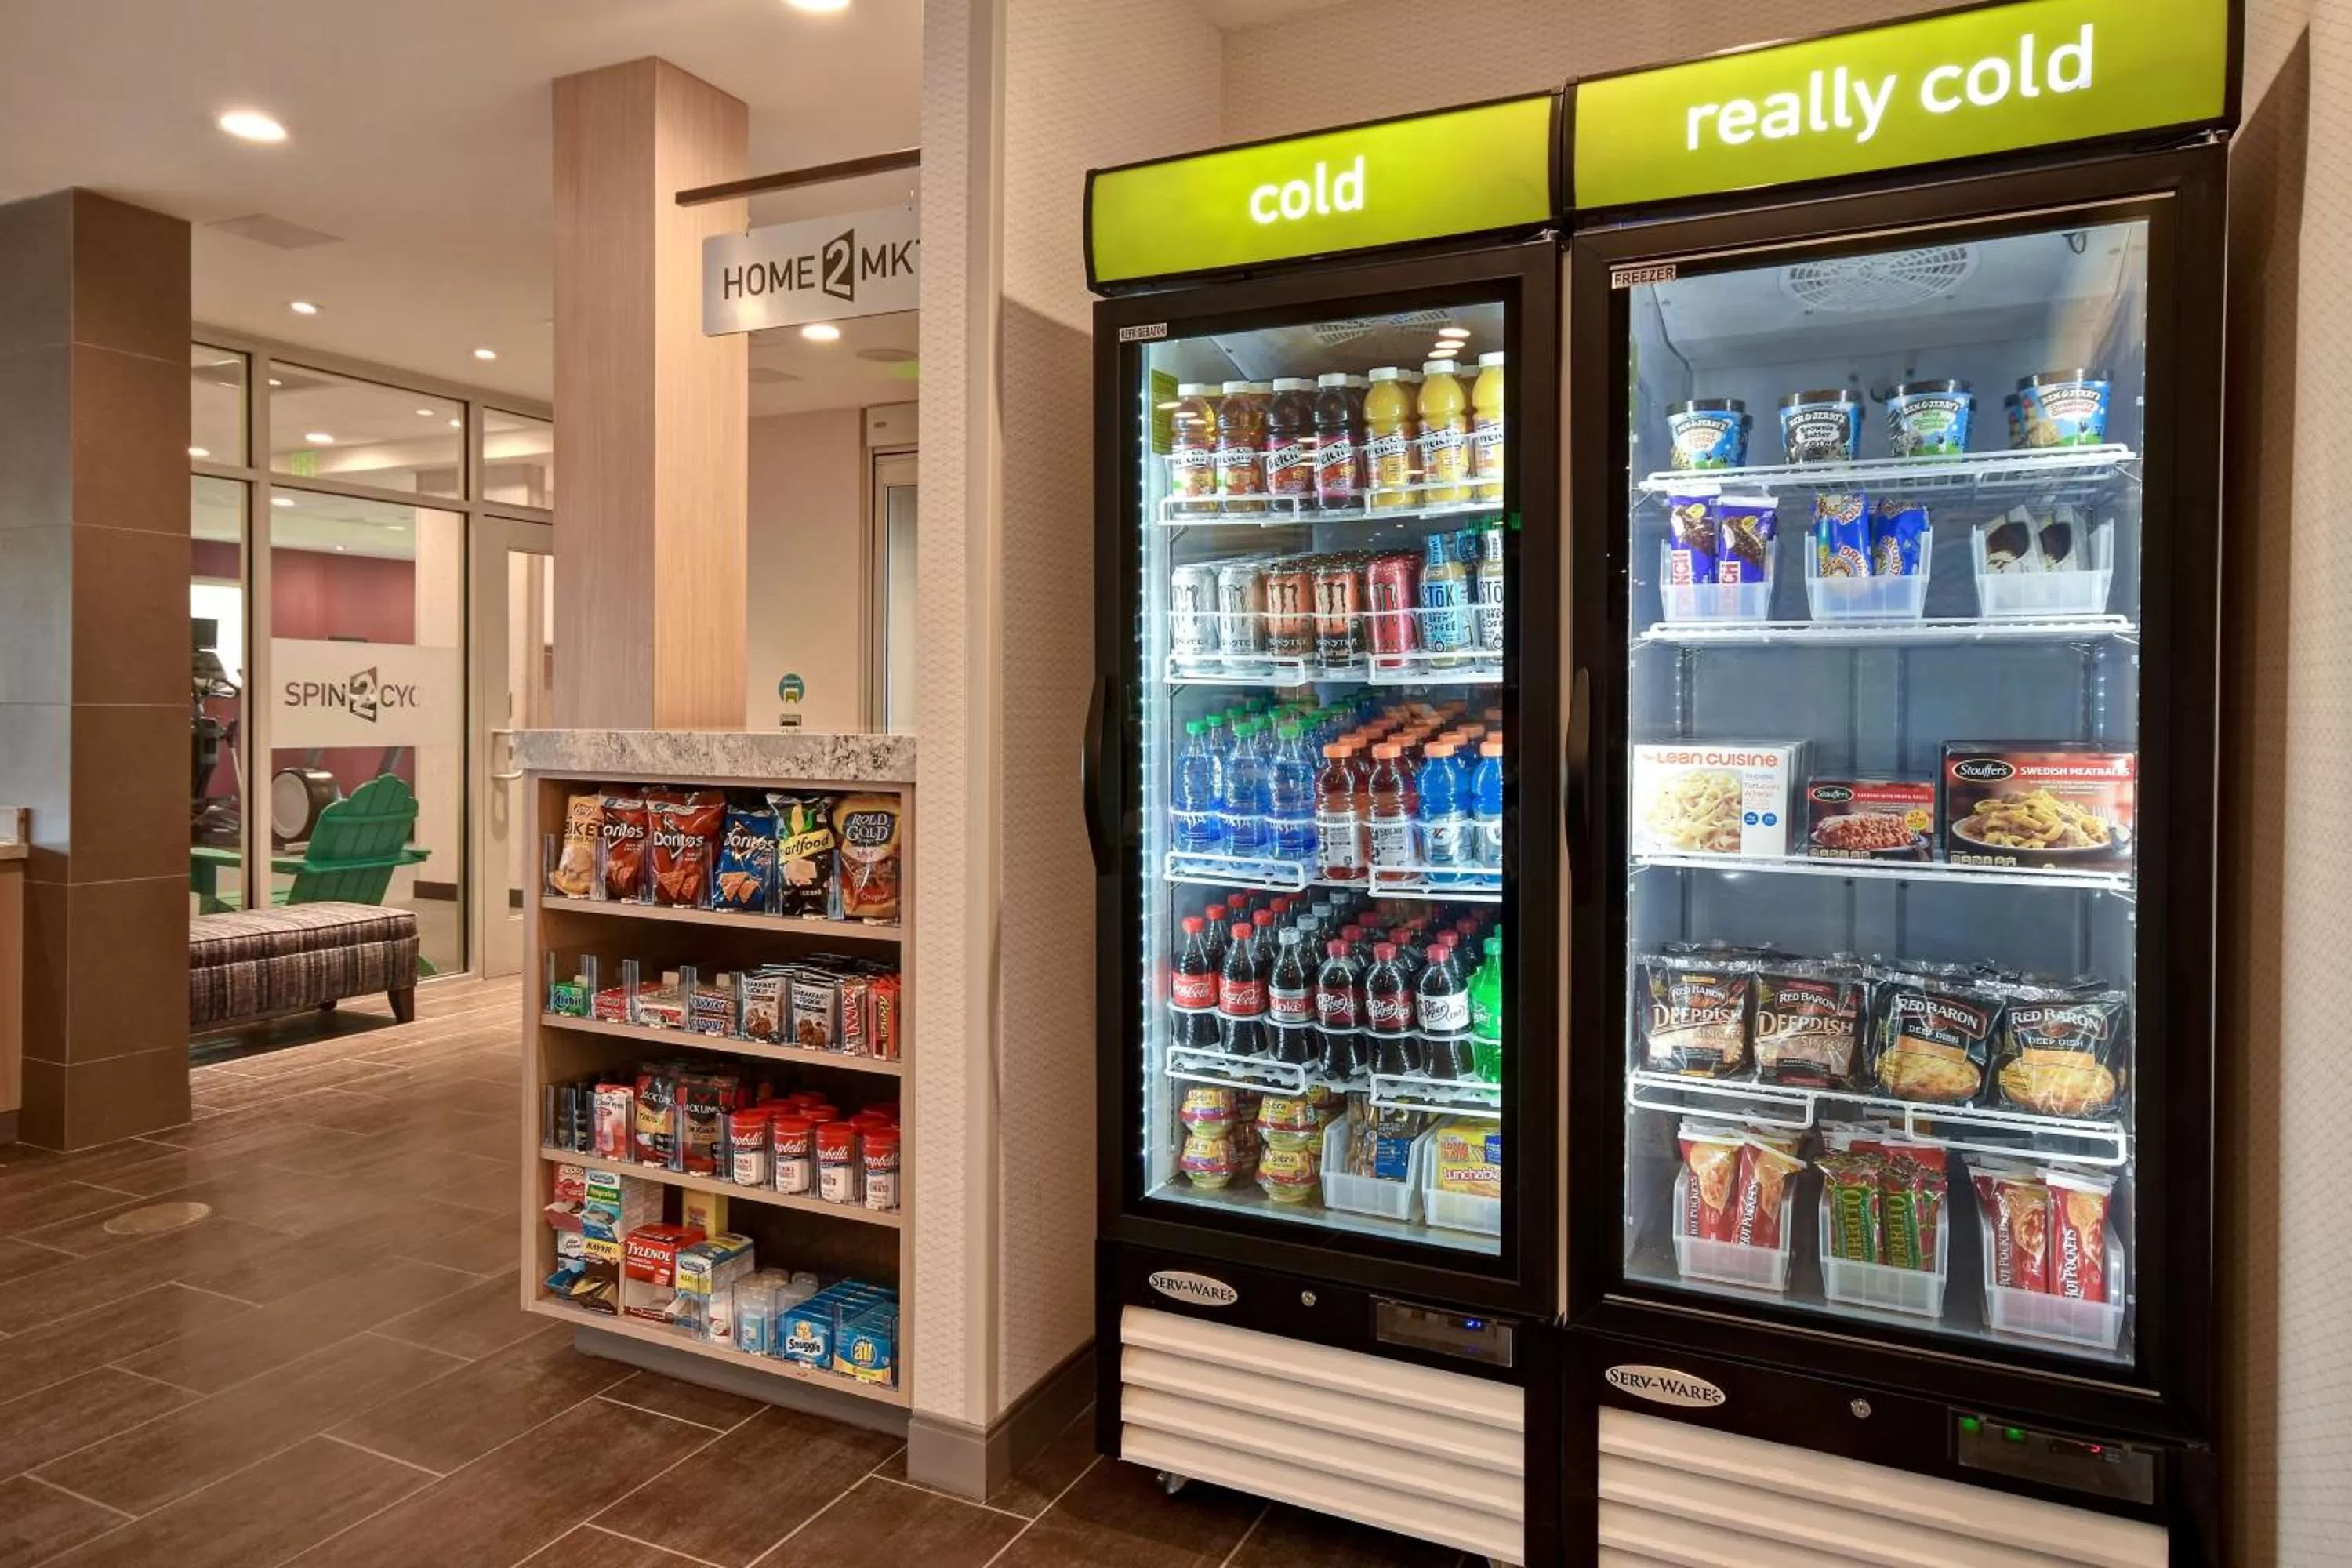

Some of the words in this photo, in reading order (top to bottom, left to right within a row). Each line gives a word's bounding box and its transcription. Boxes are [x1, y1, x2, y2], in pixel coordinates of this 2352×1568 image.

[1686, 67, 1896, 150] really
[1920, 23, 2093, 113] cold
[1249, 157, 1364, 223] cold
[724, 255, 815, 299] HOME
[825, 238, 851, 296] 2
[862, 239, 920, 281] MK
[1615, 267, 1674, 285] FREEZER
[284, 682, 346, 706] SPIN
[1959, 764, 2008, 778] Stouffer's
[2020, 767, 2067, 775] SWEDISH
[2069, 767, 2130, 776] MEATBAS
[852, 813, 889, 826] ROLD
[603, 822, 644, 838] oritos
[653, 830, 706, 848] Doritos
[846, 826, 889, 842] GOLD
[781, 835, 829, 856] artfood
[1779, 993, 1799, 1003] RED
[1801, 992, 1836, 1011] BARON
[1898, 998, 1925, 1011] RED
[1926, 1000, 1978, 1029] BARON
[2011, 1010, 2042, 1023] RED
[731, 1131, 763, 1146] mpbell's
[775, 1139, 807, 1154] mpbell's
[818, 1145, 848, 1160] mpbell's
[865, 1153, 899, 1168] mpbell's
[627, 1240, 672, 1261] TYLENOL
[1152, 1274, 1228, 1301] SERV-WARE
[789, 1339, 821, 1354] Snuggle
[853, 1341, 873, 1363] all
[1610, 1368, 1711, 1403] SERV-WARE
